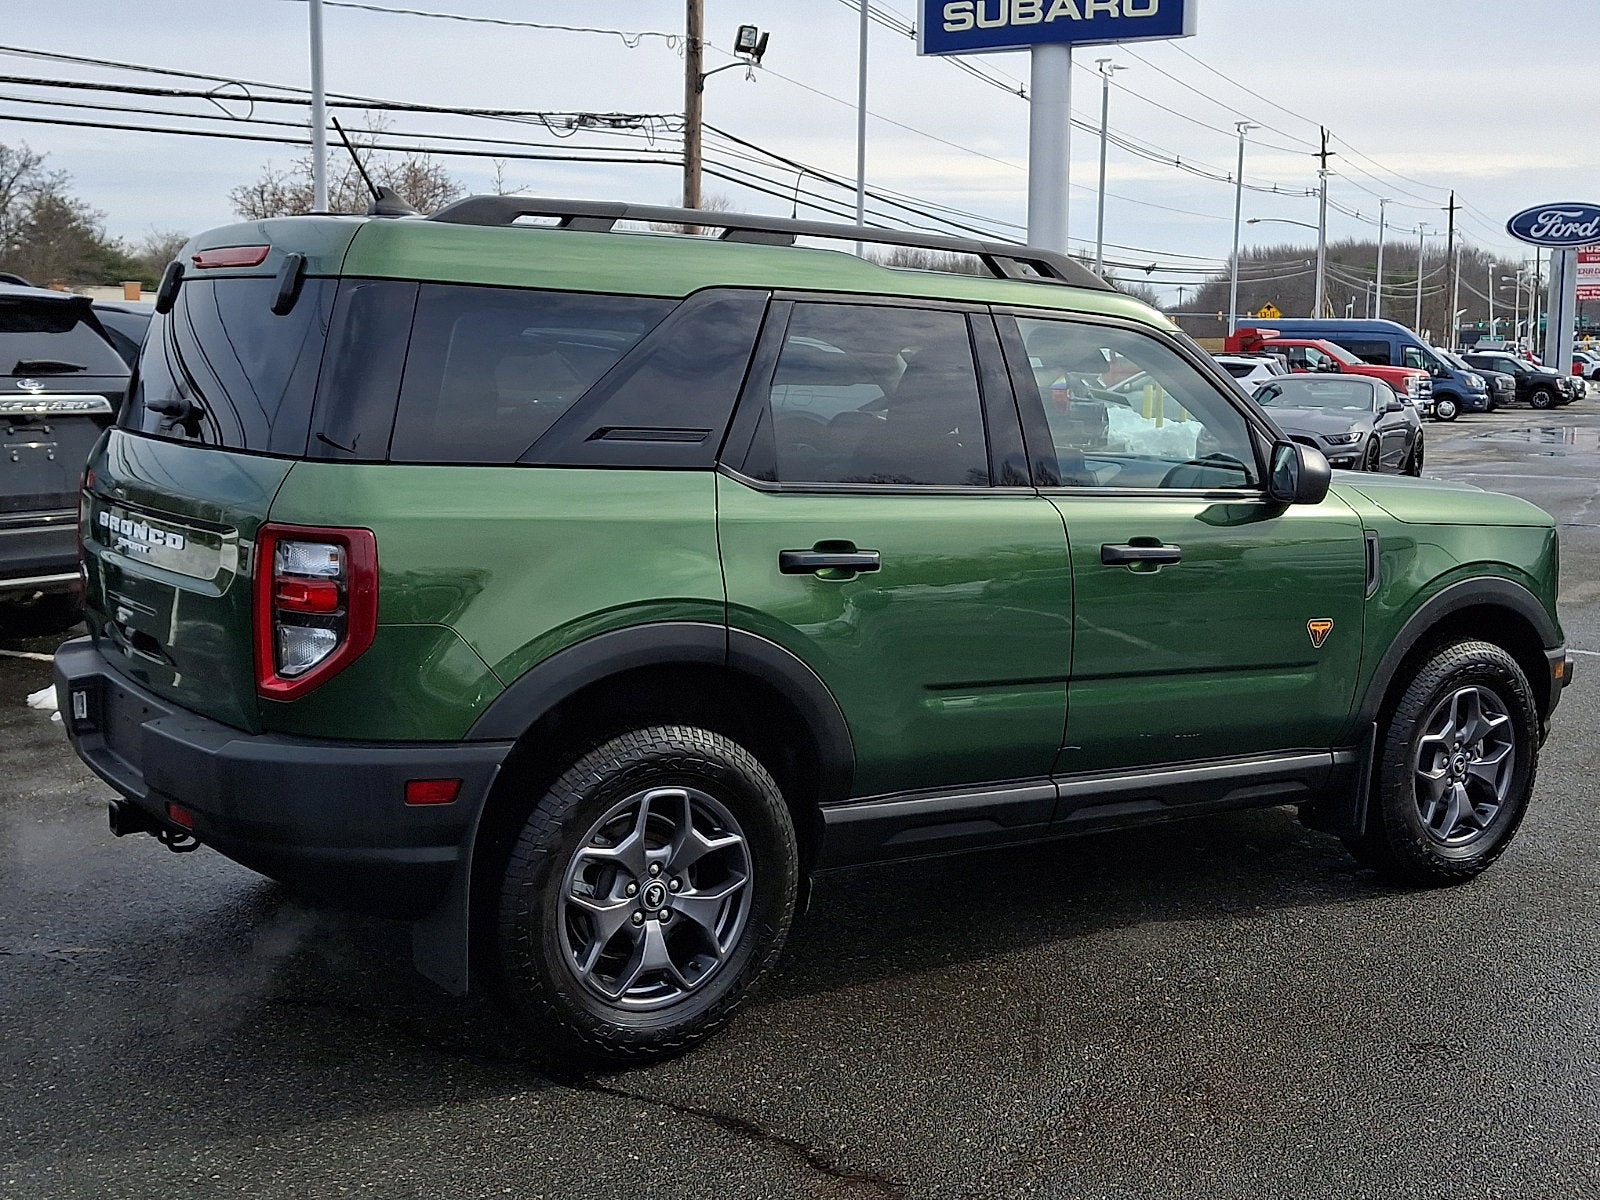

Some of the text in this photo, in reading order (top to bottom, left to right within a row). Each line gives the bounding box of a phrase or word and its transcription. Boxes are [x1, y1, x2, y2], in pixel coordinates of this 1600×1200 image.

[943, 0, 1159, 32] SUBARU
[1530, 210, 1599, 237] Ford
[99, 511, 184, 550] BRONCO
[117, 536, 150, 553] SPORT
